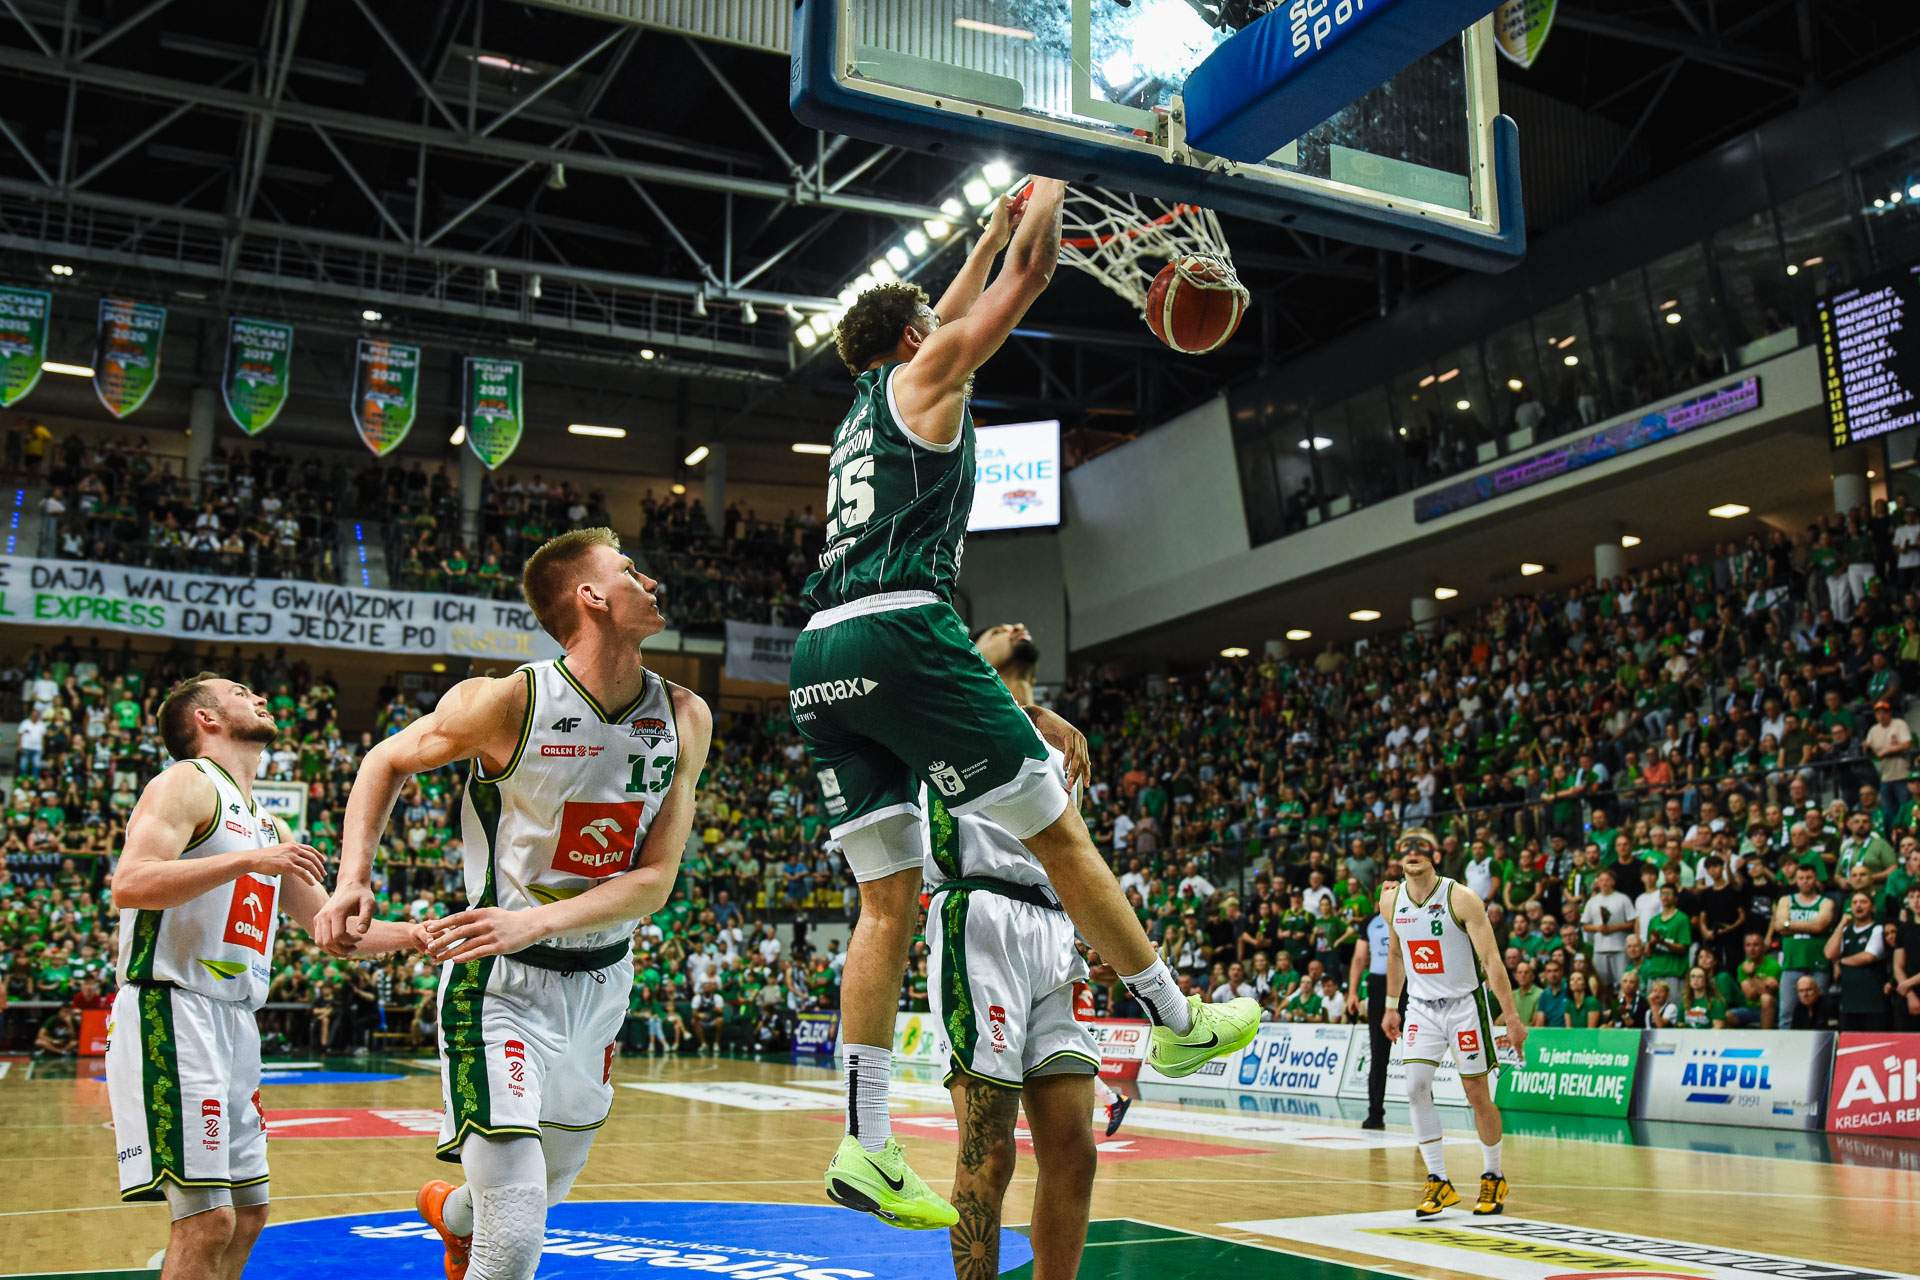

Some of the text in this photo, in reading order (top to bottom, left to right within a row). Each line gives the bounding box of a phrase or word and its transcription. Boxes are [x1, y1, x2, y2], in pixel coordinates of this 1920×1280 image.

[1835, 434, 1847, 446] 77
[124, 573, 256, 609] WALCZYĆ
[433, 601, 476, 624] ICH
[35, 593, 166, 629] EXPRESS
[181, 608, 273, 635] DALEJ
[288, 612, 385, 647] JEDZIE
[402, 626, 436, 648] PO
[789, 676, 863, 713] pompax
[551, 717, 582, 733] 4F
[543, 746, 573, 756] ORLEN
[625, 754, 676, 793] 13
[568, 850, 624, 867] ORLEN
[1431, 920, 1444, 937] 8
[1414, 961, 1439, 971] ORLEN
[1267, 1036, 1339, 1076] pij wodę
[1538, 1047, 1630, 1069] Tu jest miejsce na
[1269, 1065, 1321, 1089] kranu
[1681, 1062, 1772, 1090] ARPOL
[1510, 1070, 1627, 1106] TWOJĄ REKLAMĘ
[1737, 1094, 1761, 1108] 1991
[1835, 1111, 1893, 1130] KREACJA
